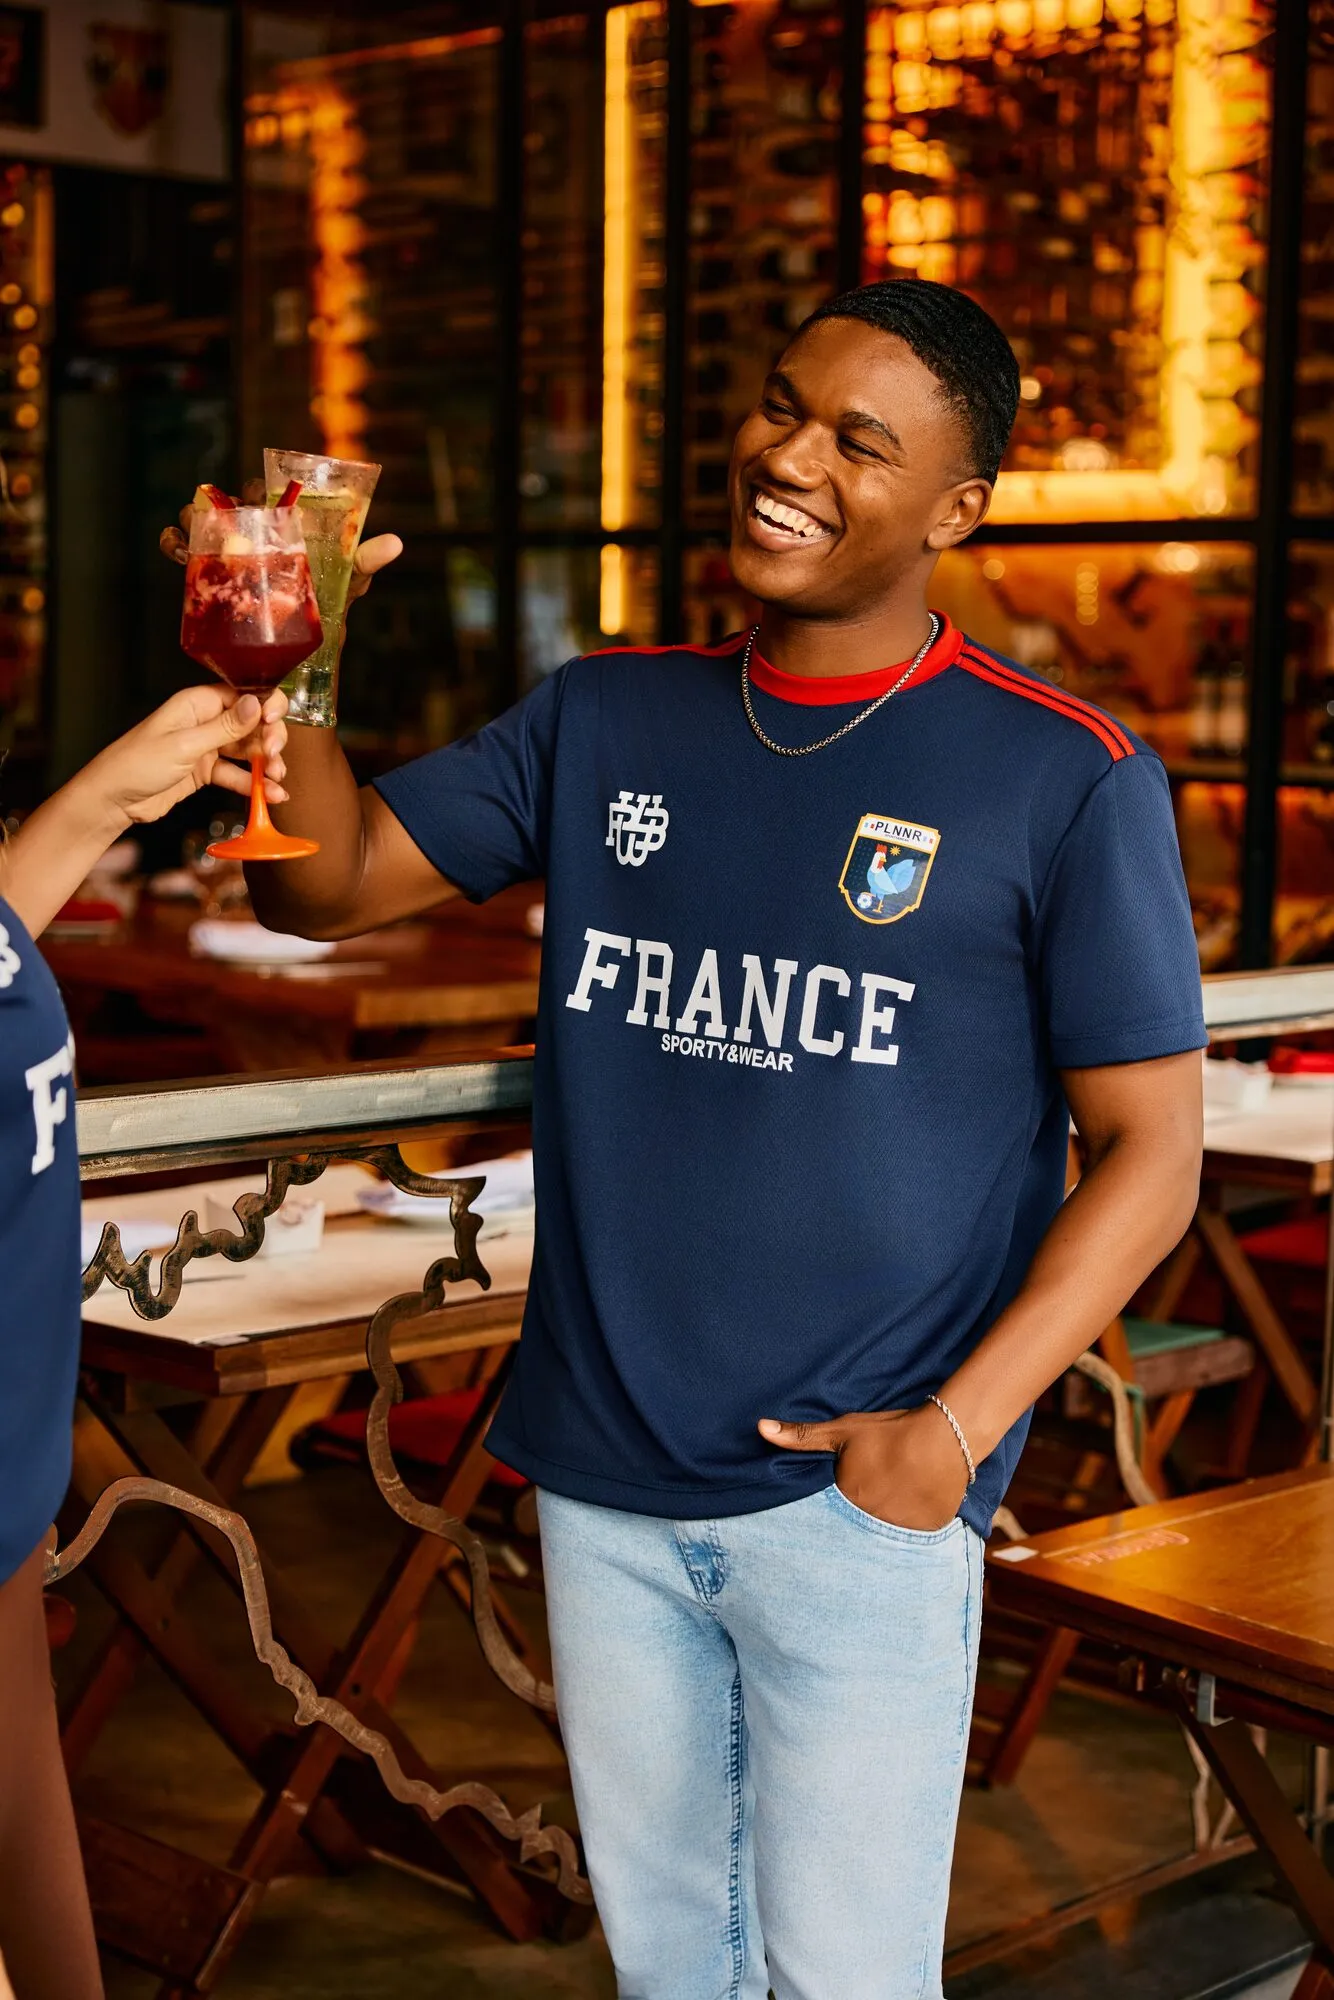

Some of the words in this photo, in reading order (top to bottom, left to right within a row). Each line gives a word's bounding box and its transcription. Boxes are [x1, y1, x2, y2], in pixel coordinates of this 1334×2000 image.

[874, 821, 922, 842] PLNNR
[565, 928, 916, 1066] FRANCE
[661, 1033, 794, 1073] SPORTY&WEAR
[25, 1031, 76, 1175] F
